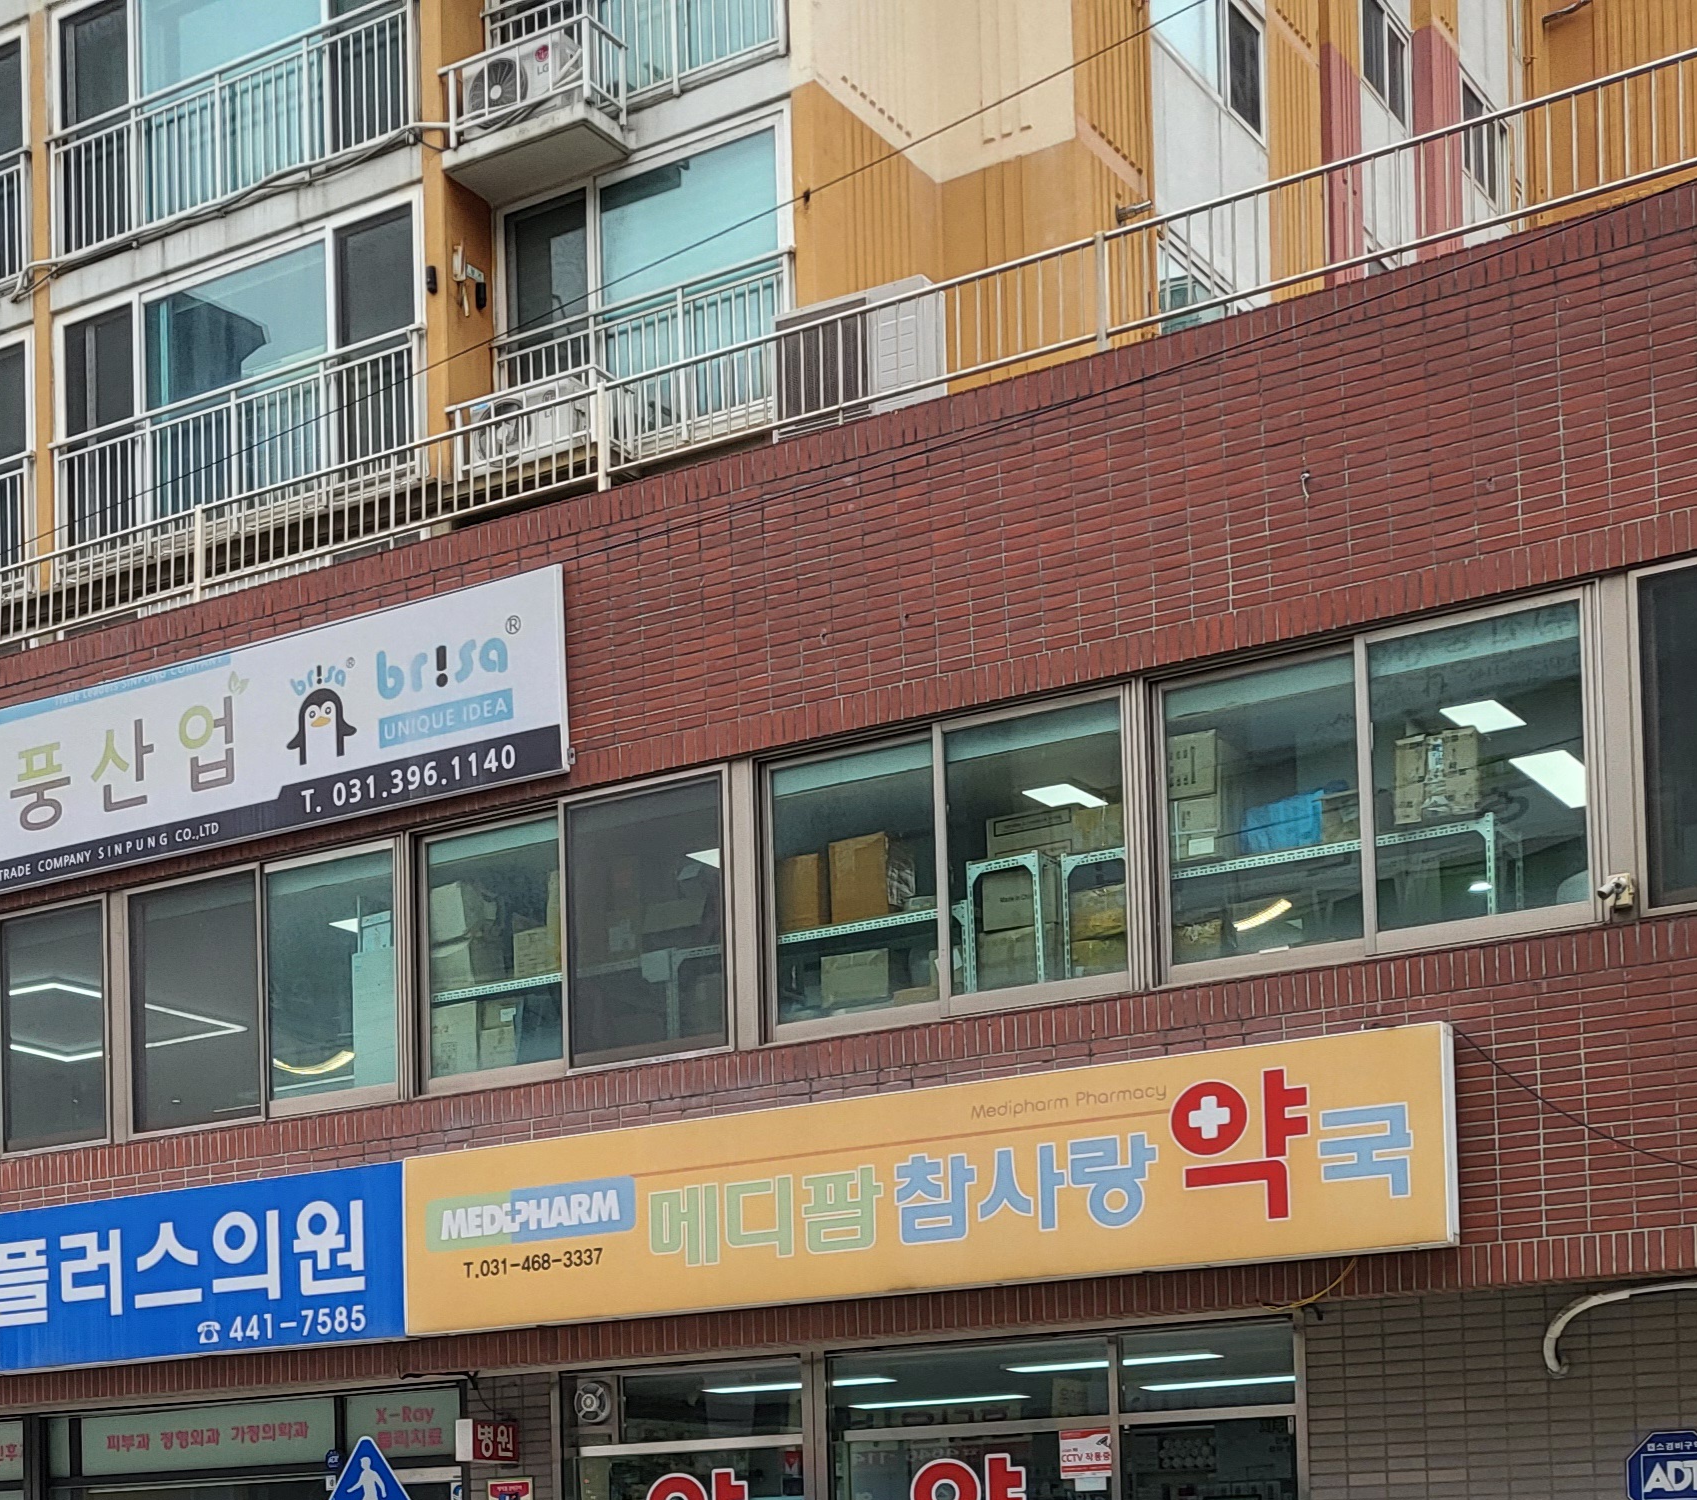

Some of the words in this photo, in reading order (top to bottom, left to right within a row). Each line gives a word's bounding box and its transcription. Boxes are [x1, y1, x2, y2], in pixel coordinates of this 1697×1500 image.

[383, 709, 454, 739] UNIQUE
[462, 698, 508, 724] IDEA
[332, 744, 516, 806] 031.396.1140
[37, 850, 92, 872] COMPANY
[98, 832, 168, 859] SINPUNG
[970, 1093, 1069, 1120] Medipharm
[1076, 1083, 1167, 1109] Pharmacy
[229, 1304, 367, 1342] 441-7585
[375, 1405, 435, 1425] X-Ray
[107, 1433, 150, 1452] 피부과
[160, 1428, 220, 1449] 정형외과
[231, 1421, 309, 1443] 가정의학과
[377, 1428, 443, 1449] 물리치료
[477, 1423, 514, 1458] 병원
[1062, 1453, 1083, 1462] CCTV
[1085, 1451, 1111, 1462] 작동중
